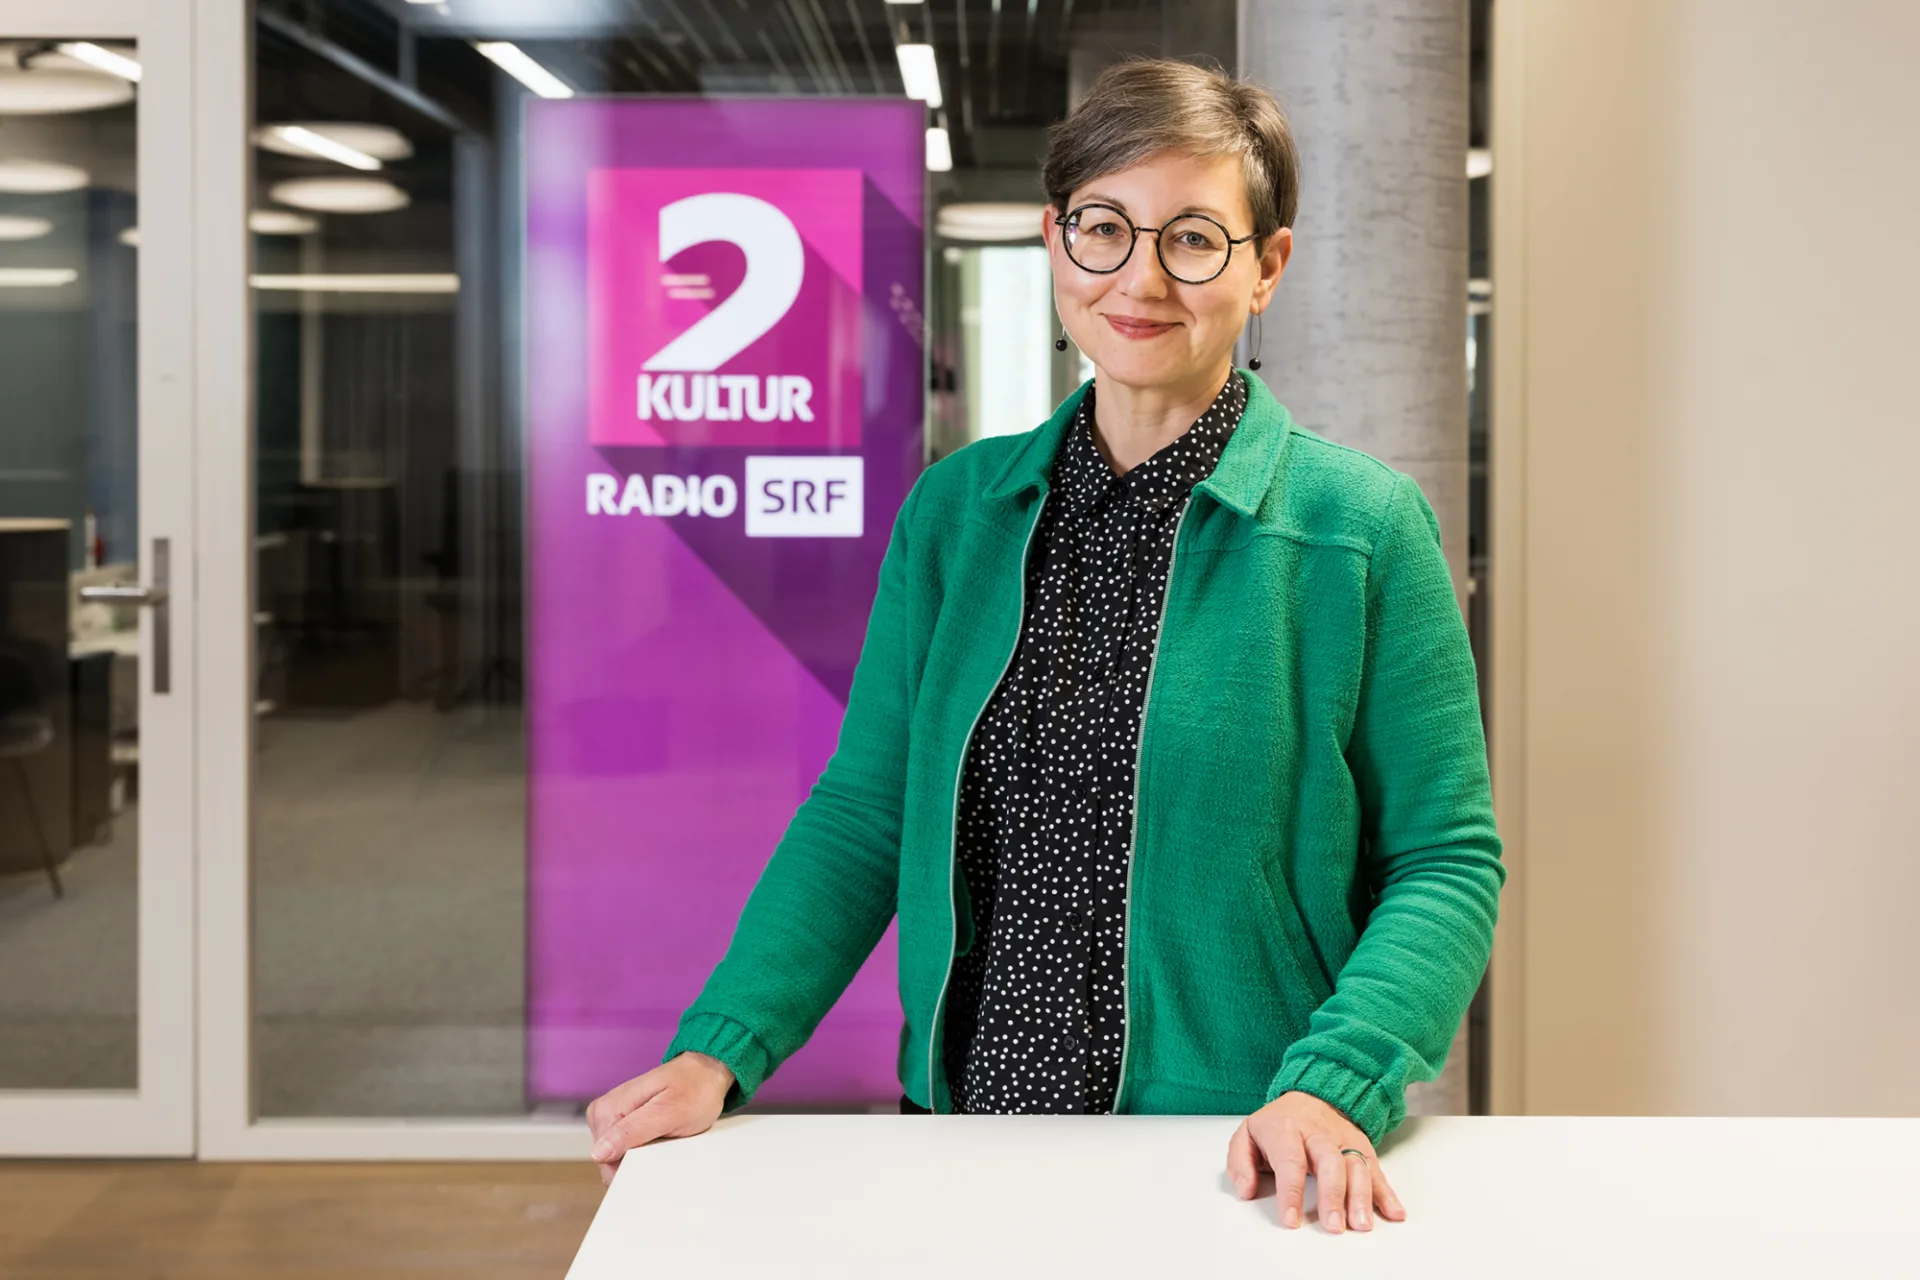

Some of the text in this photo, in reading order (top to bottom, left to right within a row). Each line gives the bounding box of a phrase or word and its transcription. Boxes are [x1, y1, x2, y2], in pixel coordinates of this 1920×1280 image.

[641, 192, 805, 371] 2
[637, 374, 814, 421] KULTUR
[586, 473, 847, 517] RADIO SRF
